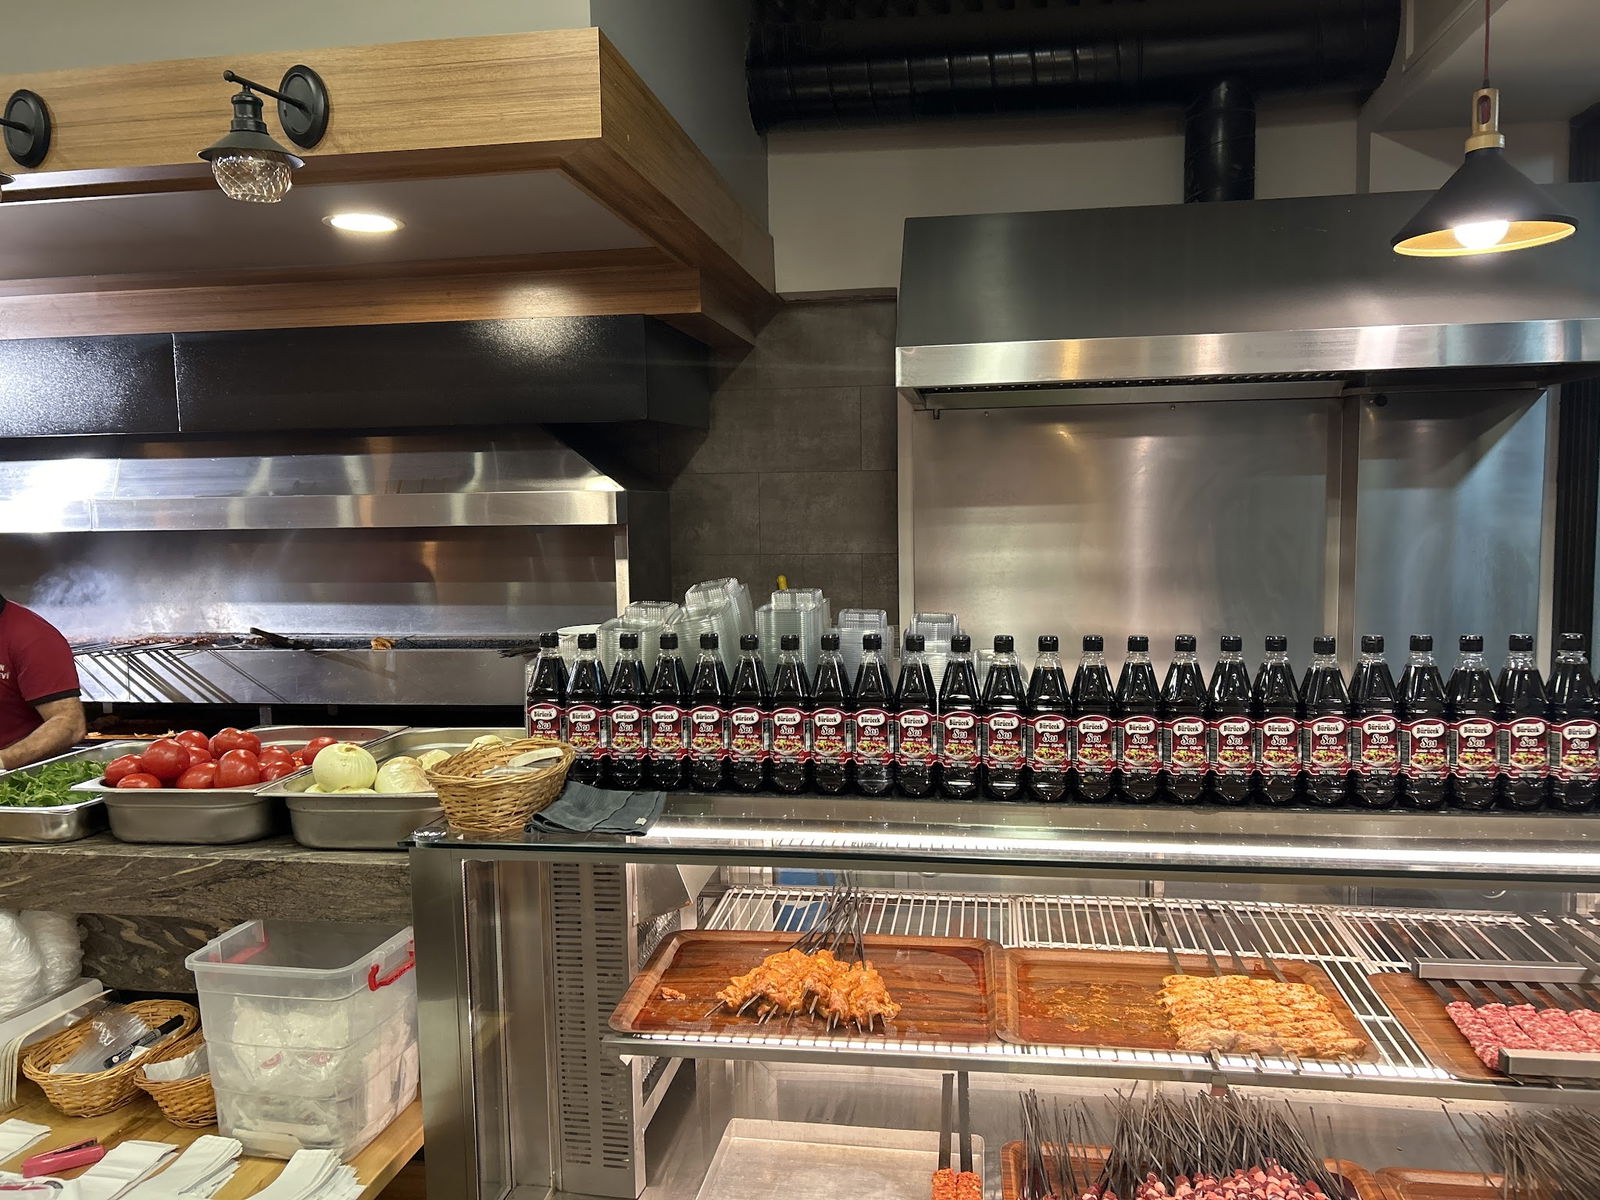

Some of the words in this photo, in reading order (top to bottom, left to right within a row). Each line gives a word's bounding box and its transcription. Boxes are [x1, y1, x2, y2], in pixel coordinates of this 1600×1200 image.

[537, 720, 552, 729] Sos
[575, 722, 590, 732] Sos
[618, 723, 633, 732] Sos
[658, 723, 673, 732] Sos
[699, 723, 713, 732] Sos
[738, 725, 753, 734] Sos
[780, 725, 795, 735] Sos
[821, 726, 836, 735] Sos
[864, 726, 879, 736] Sos
[907, 727, 922, 737] Sos
[952, 729, 968, 739] Sos
[996, 730, 1012, 740] Sos
[1042, 733, 1058, 743] Sos
[1085, 733, 1102, 743] Sos
[1132, 734, 1148, 744] Sos
[1180, 735, 1197, 745] Sos
[1226, 735, 1243, 745] Sos
[1271, 735, 1288, 746] Sos
[1320, 735, 1337, 745] Sos
[1371, 734, 1388, 744] Sos
[1419, 738, 1437, 748] Sos
[1466, 737, 1486, 747] Sos
[1519, 737, 1538, 747] Sos
[1571, 739, 1589, 749] Sos
